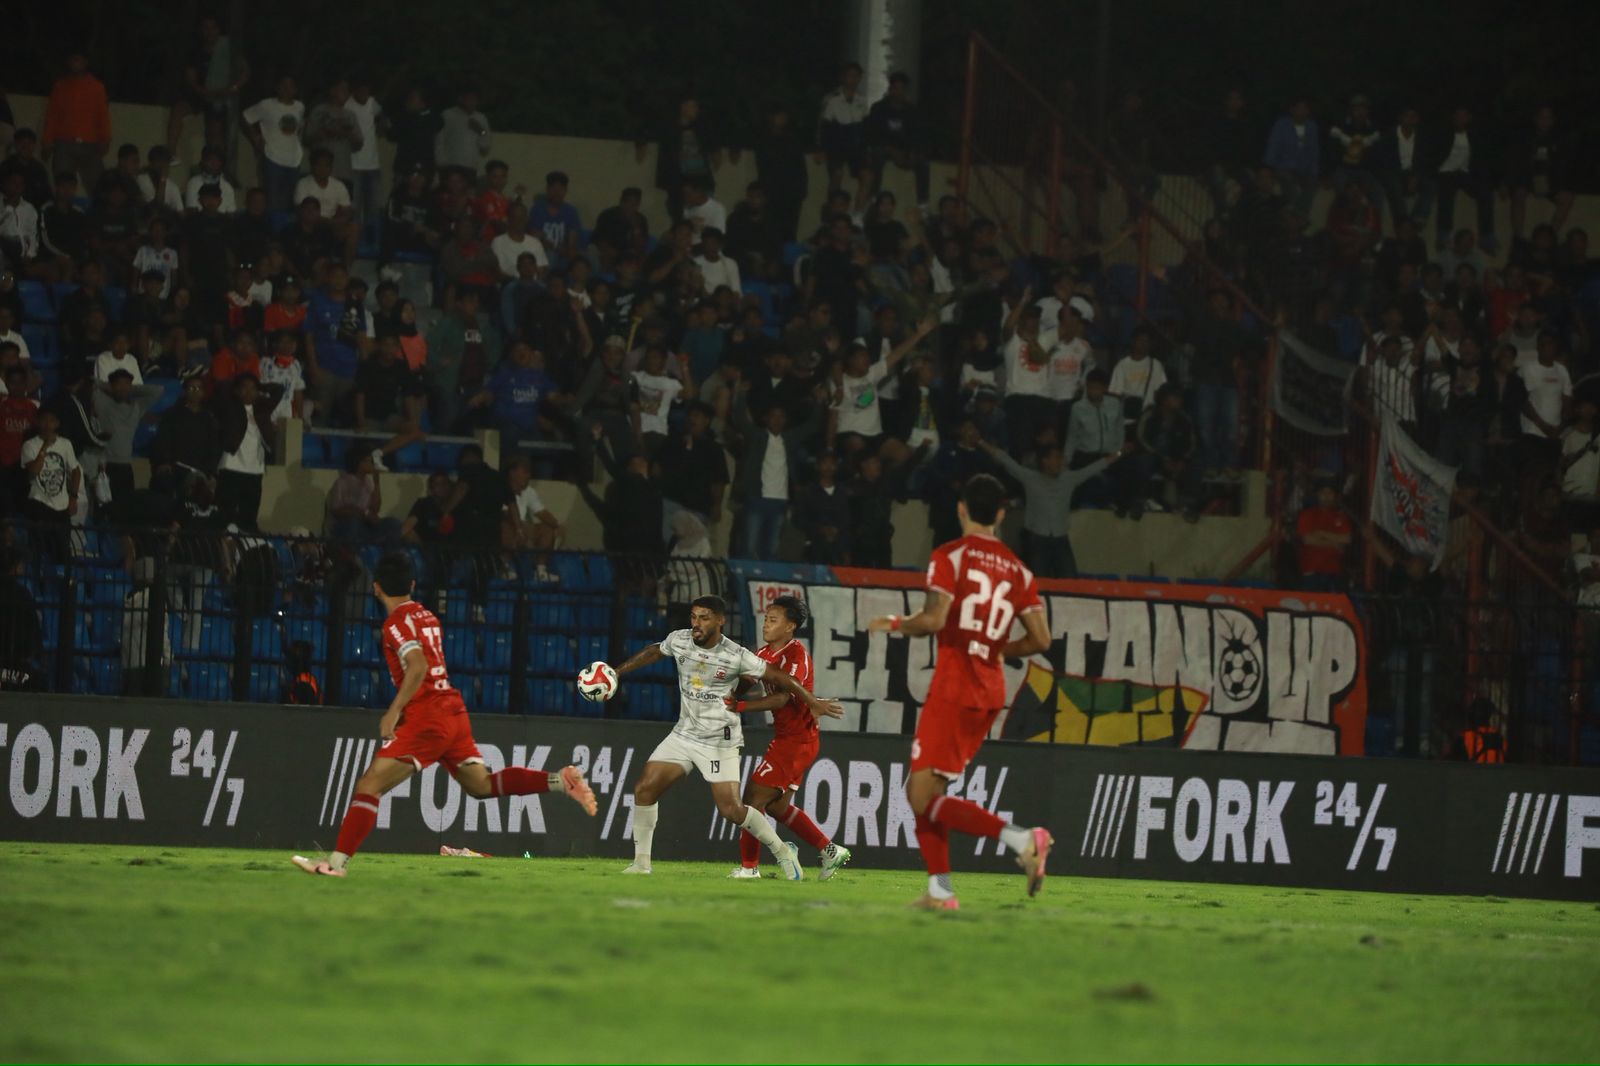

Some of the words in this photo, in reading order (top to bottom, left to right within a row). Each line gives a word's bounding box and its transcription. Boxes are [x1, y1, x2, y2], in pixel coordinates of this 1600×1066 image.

[959, 568, 1014, 640] 26
[0, 723, 150, 820] ORK
[170, 727, 245, 826] 24/7
[710, 760, 720, 774] 19
[764, 756, 920, 849] ORK
[1133, 776, 1296, 864] FORK
[1313, 780, 1398, 871] 24/7
